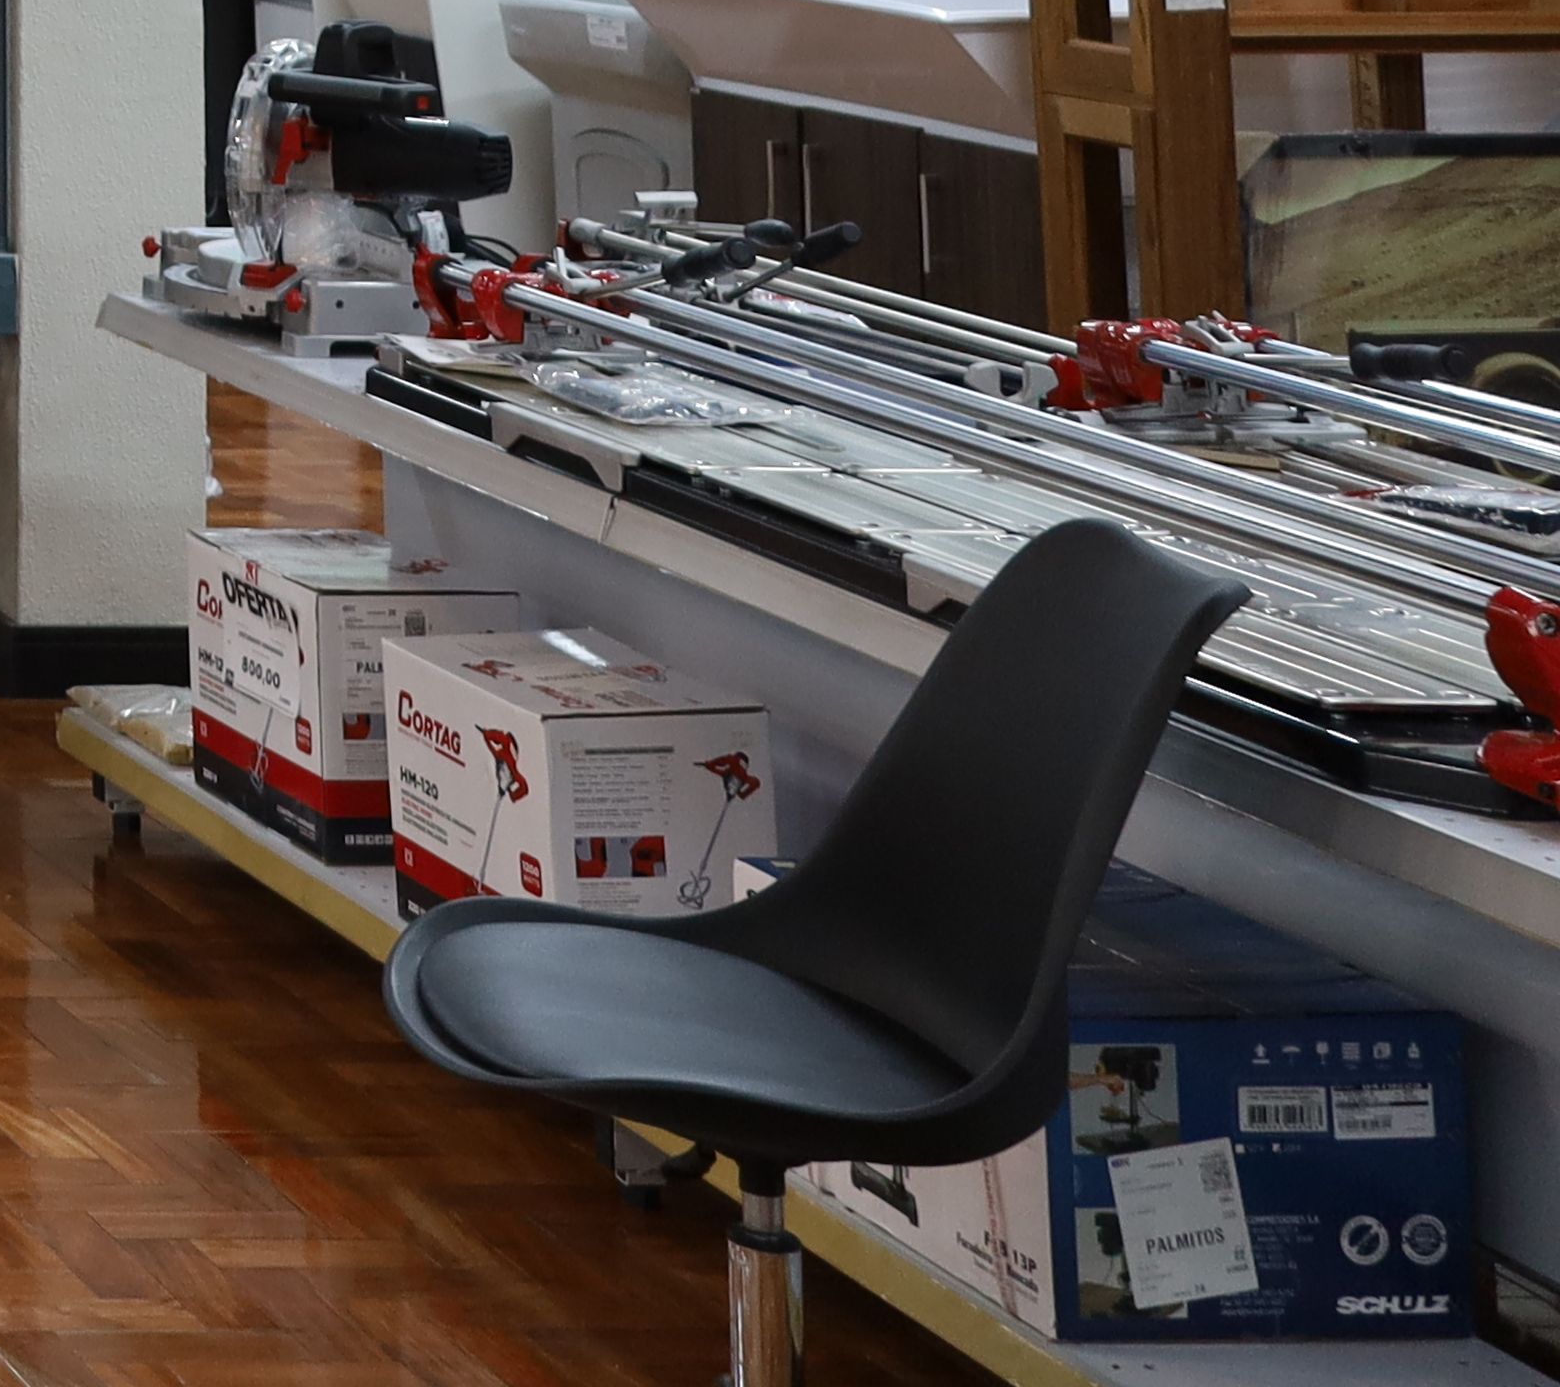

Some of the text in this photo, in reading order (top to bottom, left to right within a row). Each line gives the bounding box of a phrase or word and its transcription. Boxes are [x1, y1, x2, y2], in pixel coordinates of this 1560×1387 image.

[242, 656, 280, 688] 800,00
[400, 765, 439, 800] HM-120
[1145, 1226, 1225, 1255] PALMITOS
[1336, 1295, 1450, 1315] SCHULZ
